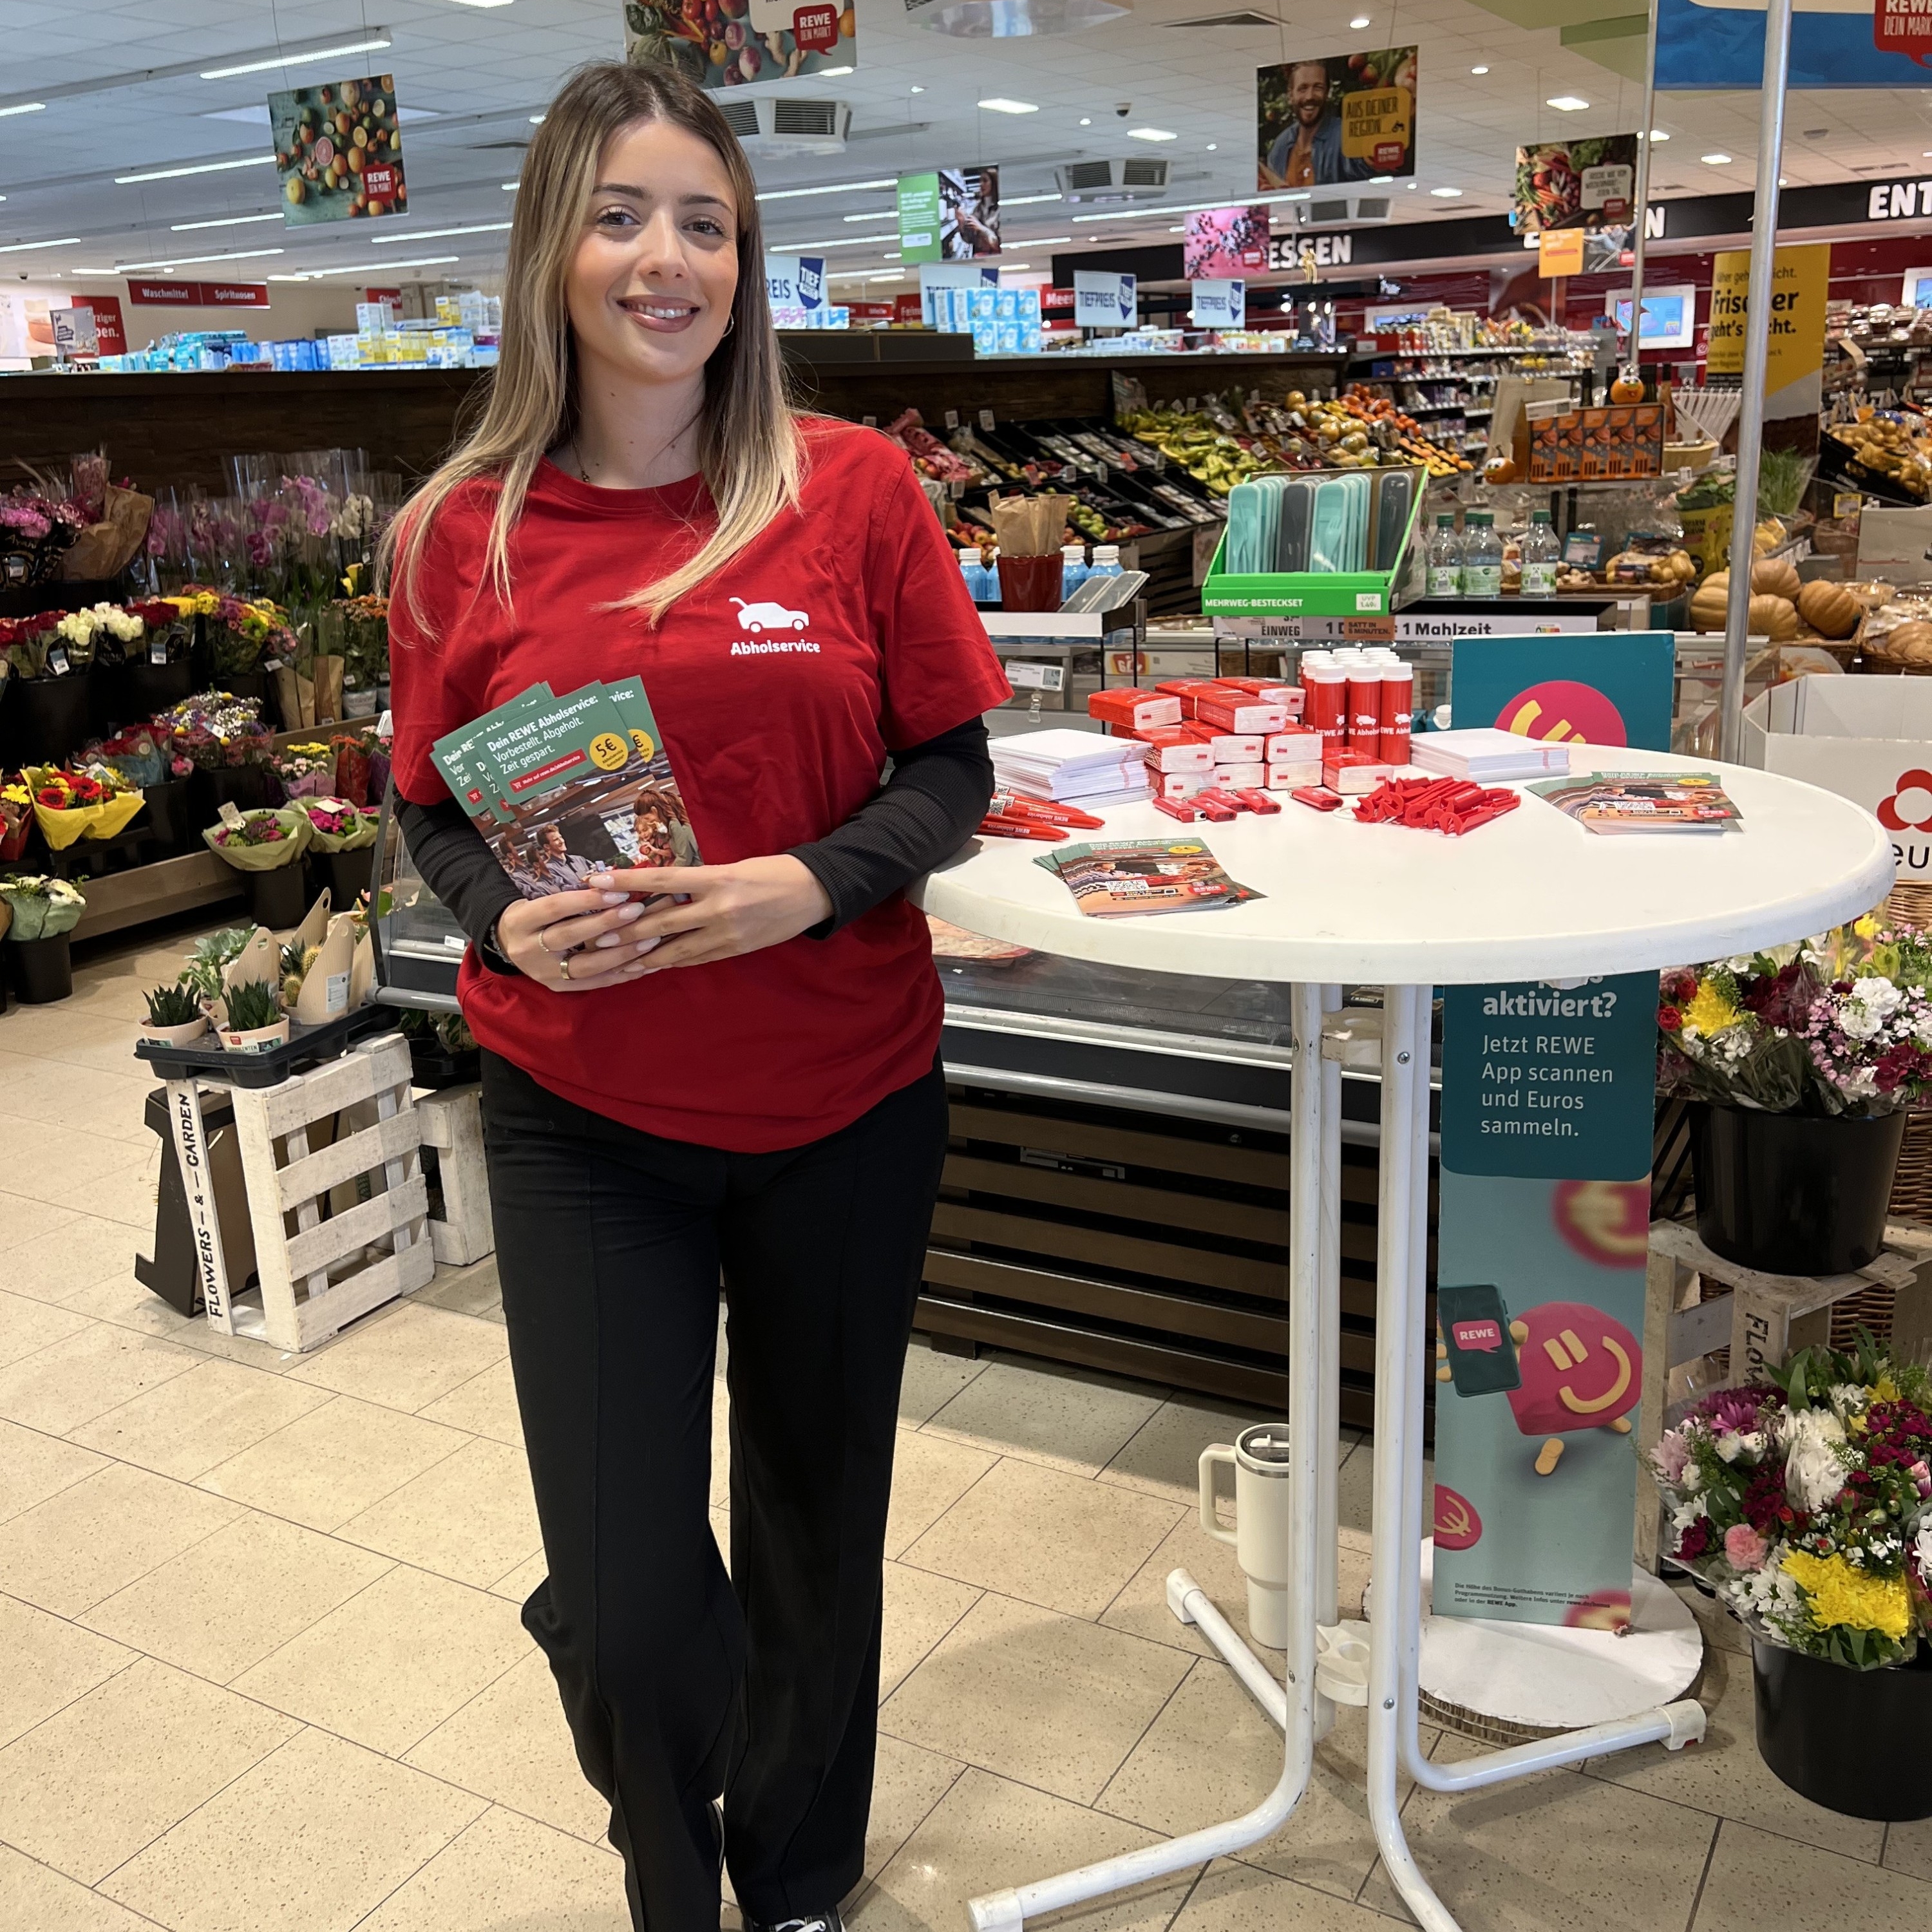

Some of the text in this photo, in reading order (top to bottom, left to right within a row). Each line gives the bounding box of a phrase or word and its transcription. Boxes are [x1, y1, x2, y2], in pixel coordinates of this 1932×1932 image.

[799, 12, 831, 28] REWE
[1884, 15, 1905, 36] DEIN
[1347, 97, 1398, 120] AUS DEINER
[367, 170, 391, 184] REWE
[801, 266, 820, 285] TIEF
[142, 287, 256, 301] Waschmittel Spirituosen
[1205, 599, 1303, 607] MEHRWEG-BESTECKSET
[1261, 625, 1300, 636] EINWEG
[1403, 622, 1492, 636] 1 Mahlzeit
[730, 638, 820, 656] Abholservice
[487, 737, 510, 752] Dein
[508, 721, 538, 742] REWE
[538, 696, 599, 728] Abholservice:
[493, 716, 584, 763] Vorbestellt. Abgeholt.
[500, 745, 556, 775] Zeit gespart.
[522, 775, 534, 785] Mehr
[540, 754, 581, 777] rewe.de/abholservice
[1027, 811, 1053, 820] Abholservice
[1482, 990, 1617, 1018] aktiviert?
[1482, 1035, 1595, 1055] Jetzt REWE
[1482, 1062, 1613, 1084] App scannen
[1482, 1090, 1584, 1110] und Euros
[1481, 1118, 1579, 1137] sammeln.
[178, 1093, 223, 1318] FLOWERS & GARDEN
[1459, 1328, 1495, 1341] REWE
